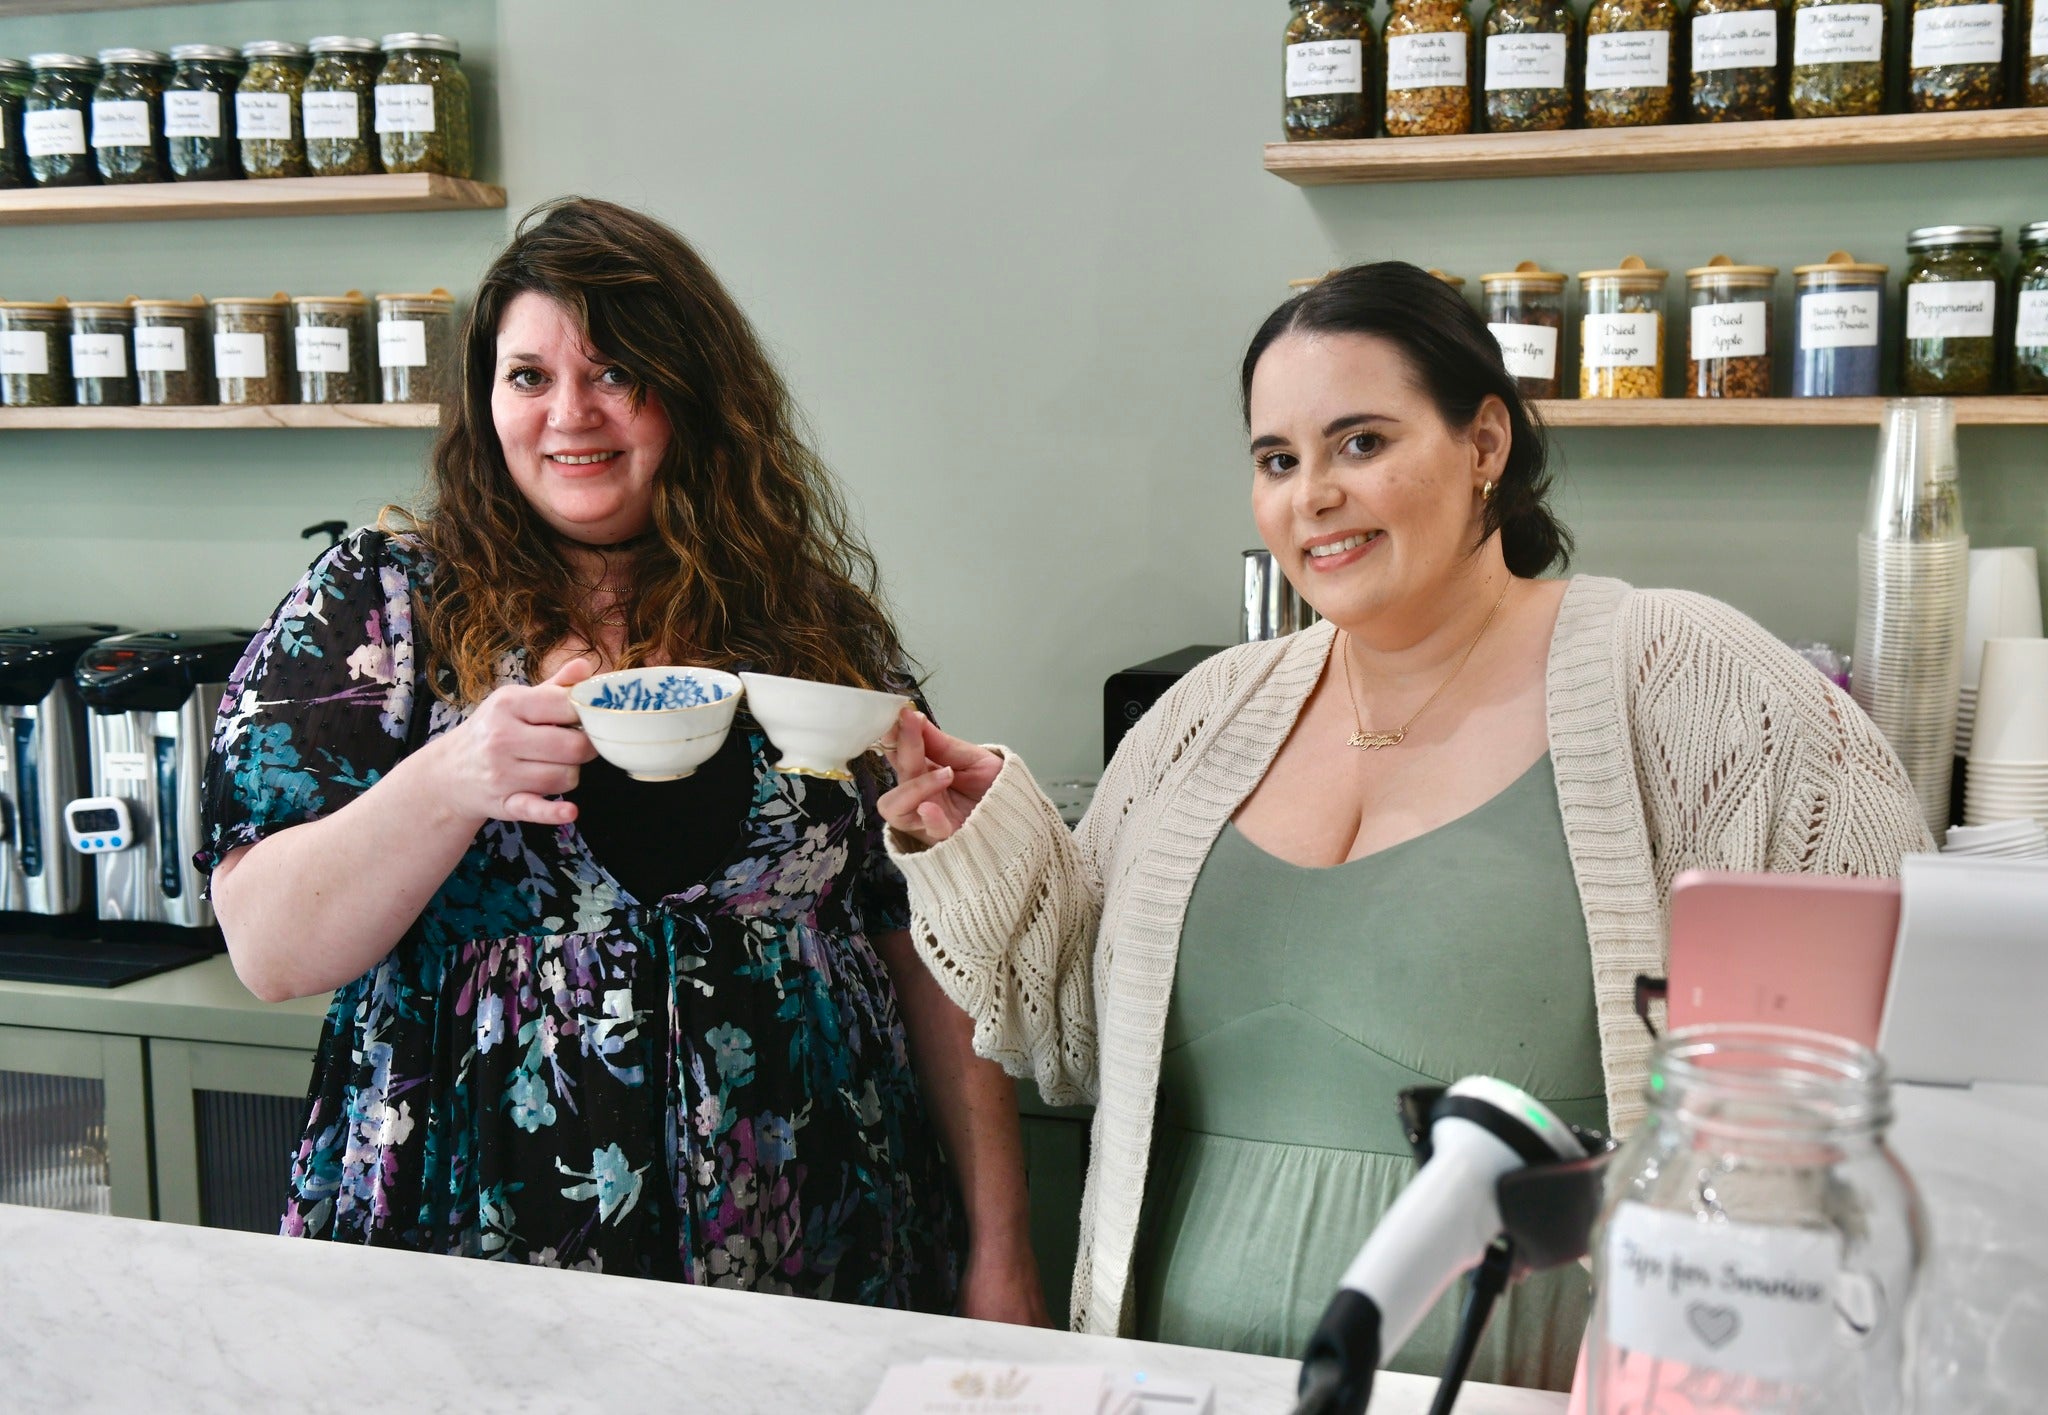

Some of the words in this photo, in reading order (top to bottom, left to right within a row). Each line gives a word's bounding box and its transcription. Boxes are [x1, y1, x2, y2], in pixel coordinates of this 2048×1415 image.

[1812, 304, 1848, 318] Butterfly
[1914, 300, 1985, 320] Peppermint
[1711, 313, 1744, 327] Dried
[1605, 323, 1637, 337] Dried
[1710, 333, 1745, 352] Apple
[1600, 344, 1639, 361] Mango
